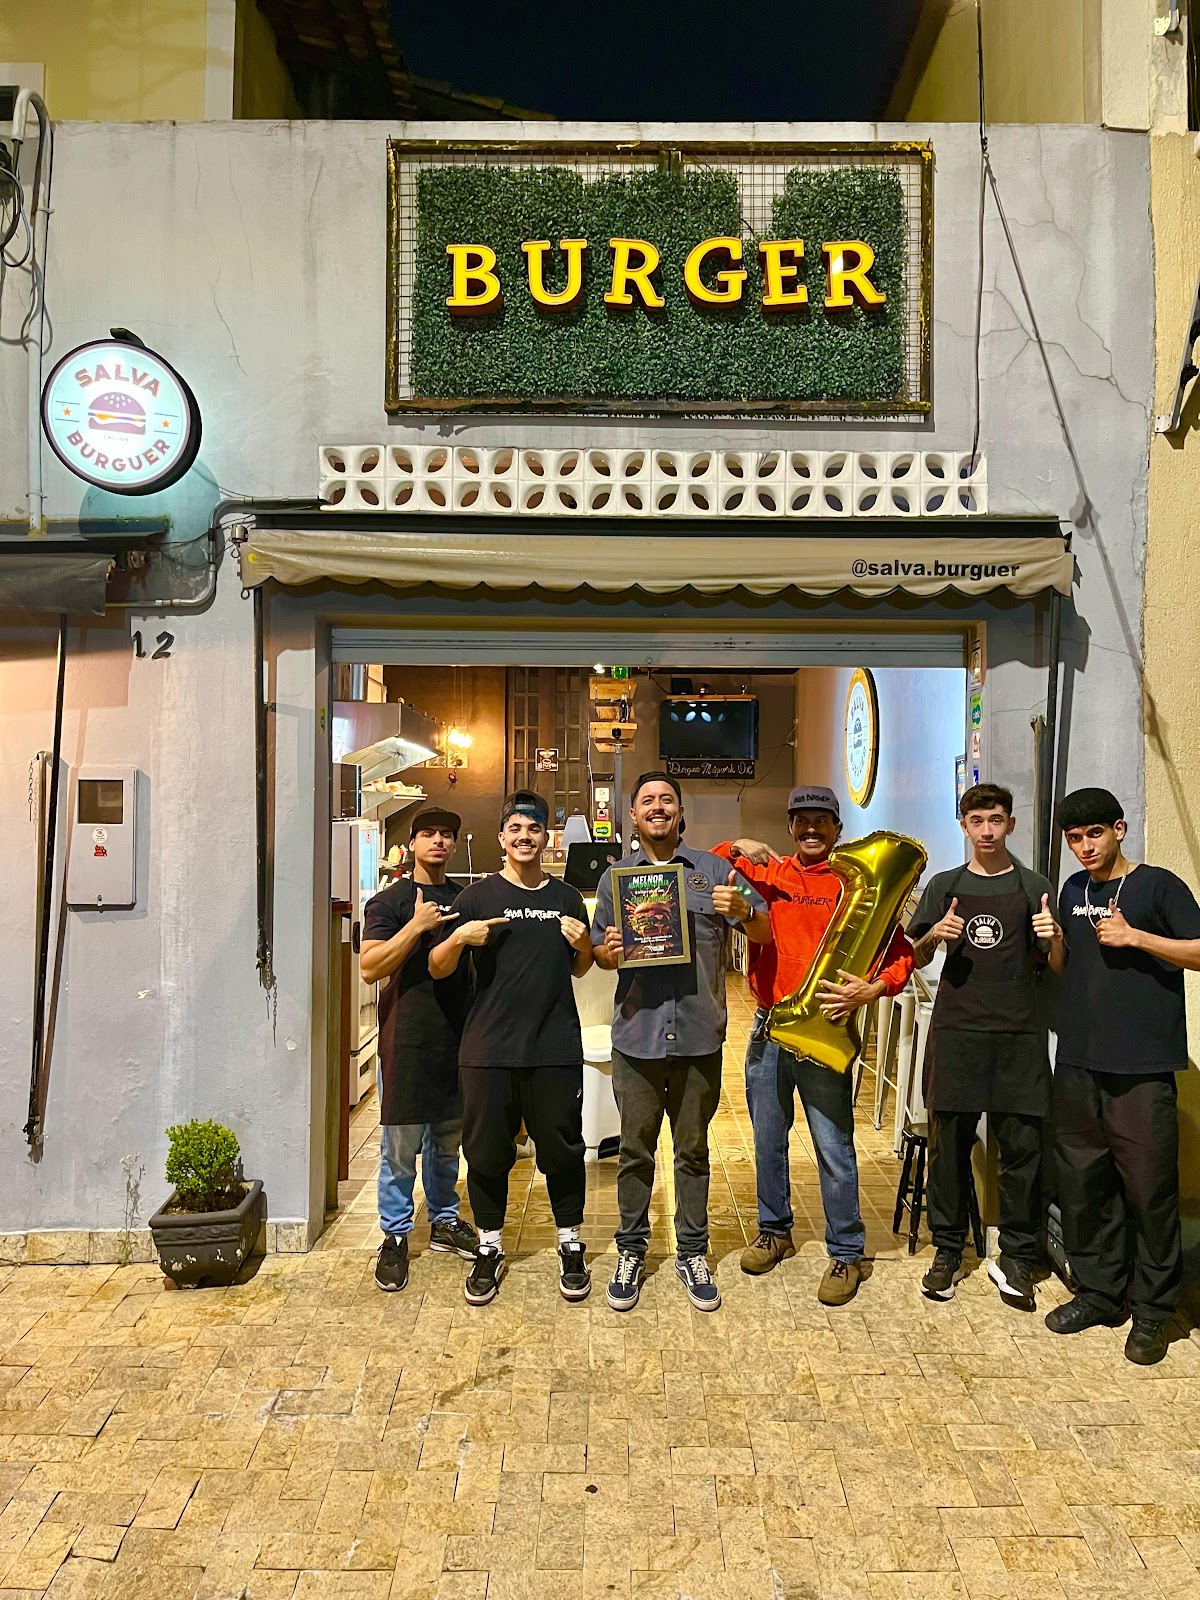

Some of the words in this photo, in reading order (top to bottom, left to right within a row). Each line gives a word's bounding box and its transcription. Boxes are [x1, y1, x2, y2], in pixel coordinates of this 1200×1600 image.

[445, 236, 887, 311] BURGER
[74, 363, 161, 398] SALVA
[66, 430, 171, 472] BURGUER
[851, 559, 1020, 581] @salva.burguer
[132, 630, 175, 660] 12
[524, 907, 561, 922] BURGUER
[792, 893, 833, 913] BURGUER
[974, 917, 996, 927] SALVA
